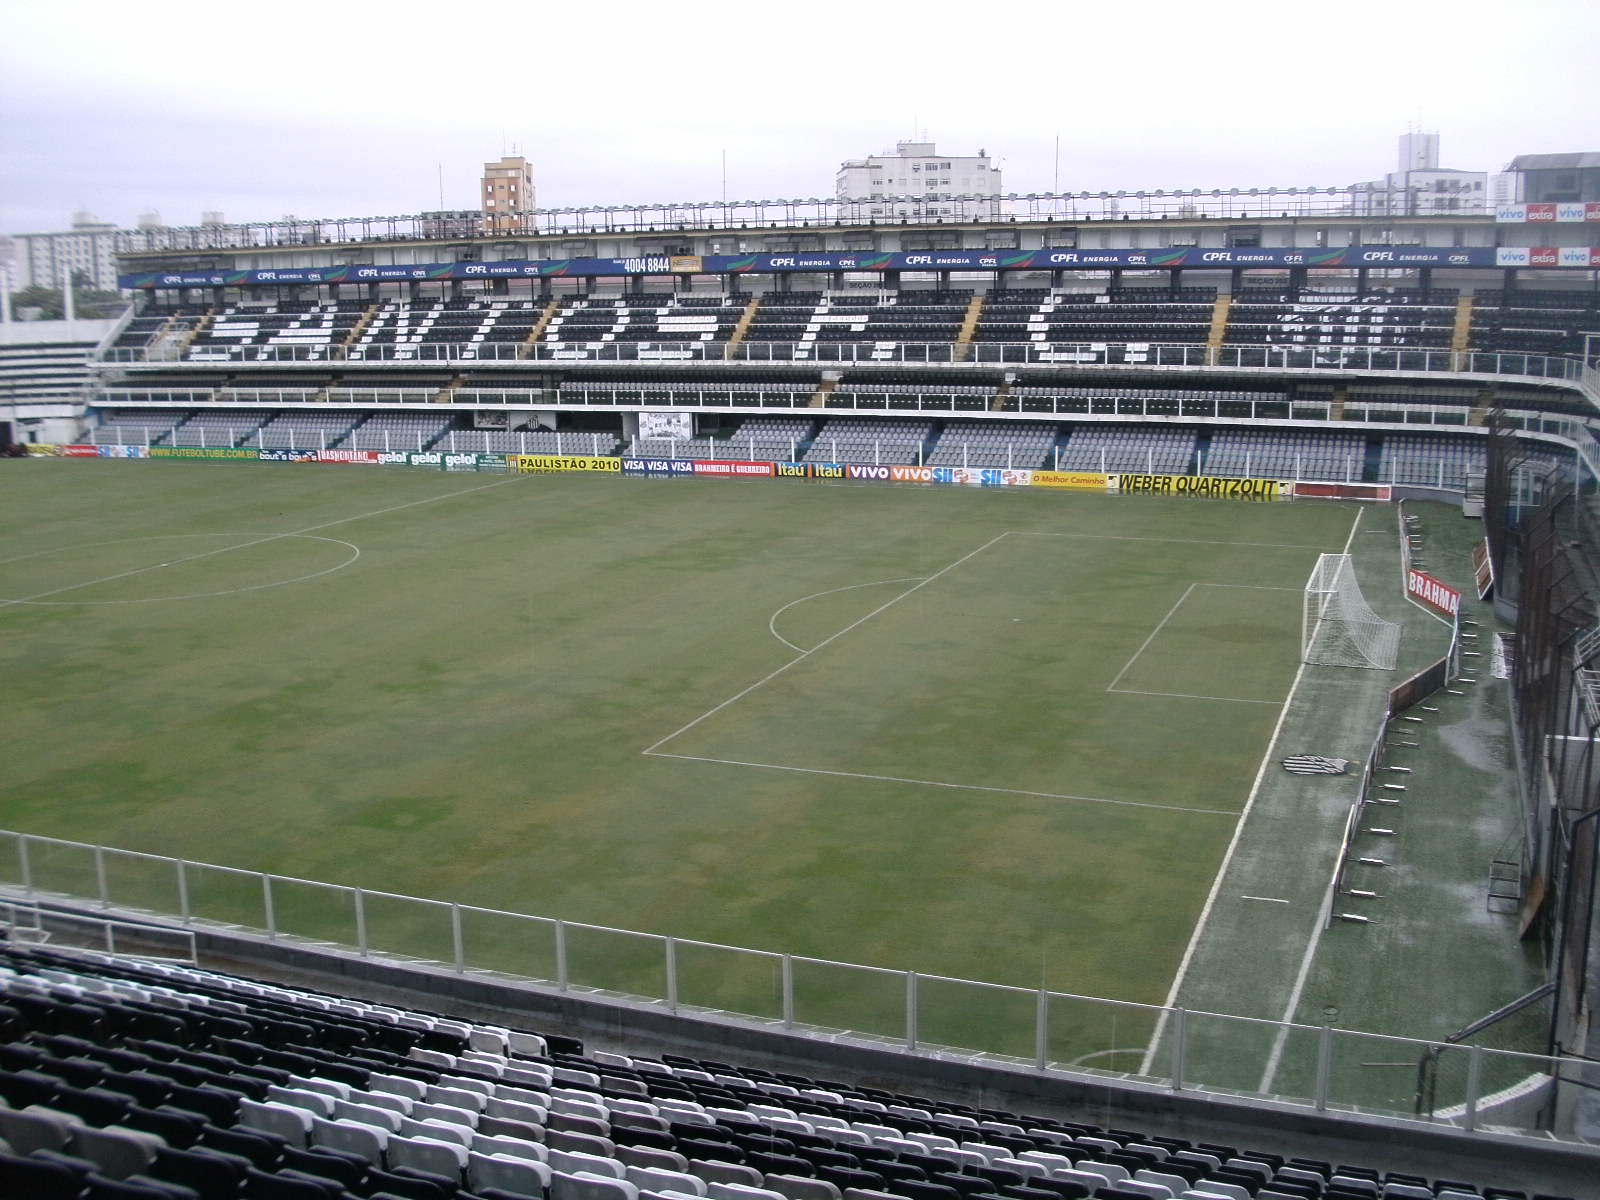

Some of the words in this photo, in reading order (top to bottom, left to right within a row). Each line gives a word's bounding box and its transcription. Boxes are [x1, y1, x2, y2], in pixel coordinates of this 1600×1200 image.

[1560, 205, 1583, 217] vivo
[770, 258, 795, 266] CPFL
[905, 256, 932, 265] CPFL
[1050, 253, 1079, 263] CPFL
[1202, 252, 1232, 261] CPFL
[1363, 251, 1394, 261] CPFL
[465, 265, 487, 274] CPFL
[624, 258, 645, 273] 4004
[647, 257, 669, 272] 8844
[358, 269, 378, 278] CPFL
[377, 451, 407, 464] gelol
[411, 452, 442, 465] gelol
[445, 453, 477, 467] gelol
[520, 457, 587, 469] PAULISTÃO
[591, 460, 620, 470] 2010
[623, 460, 645, 470] VISA
[647, 461, 669, 471] VISA
[671, 461, 693, 472] VISA
[778, 461, 805, 477] Itaú
[815, 463, 843, 478] Itaú
[850, 466, 889, 479] VIVO
[893, 467, 931, 481] VIVO
[1041, 475, 1069, 484] Melhor
[1071, 476, 1105, 485] Caminho
[1118, 474, 1173, 491] WEBER
[1175, 476, 1278, 496] QUARTZOLIT
[1409, 572, 1458, 614] BRAHMA
